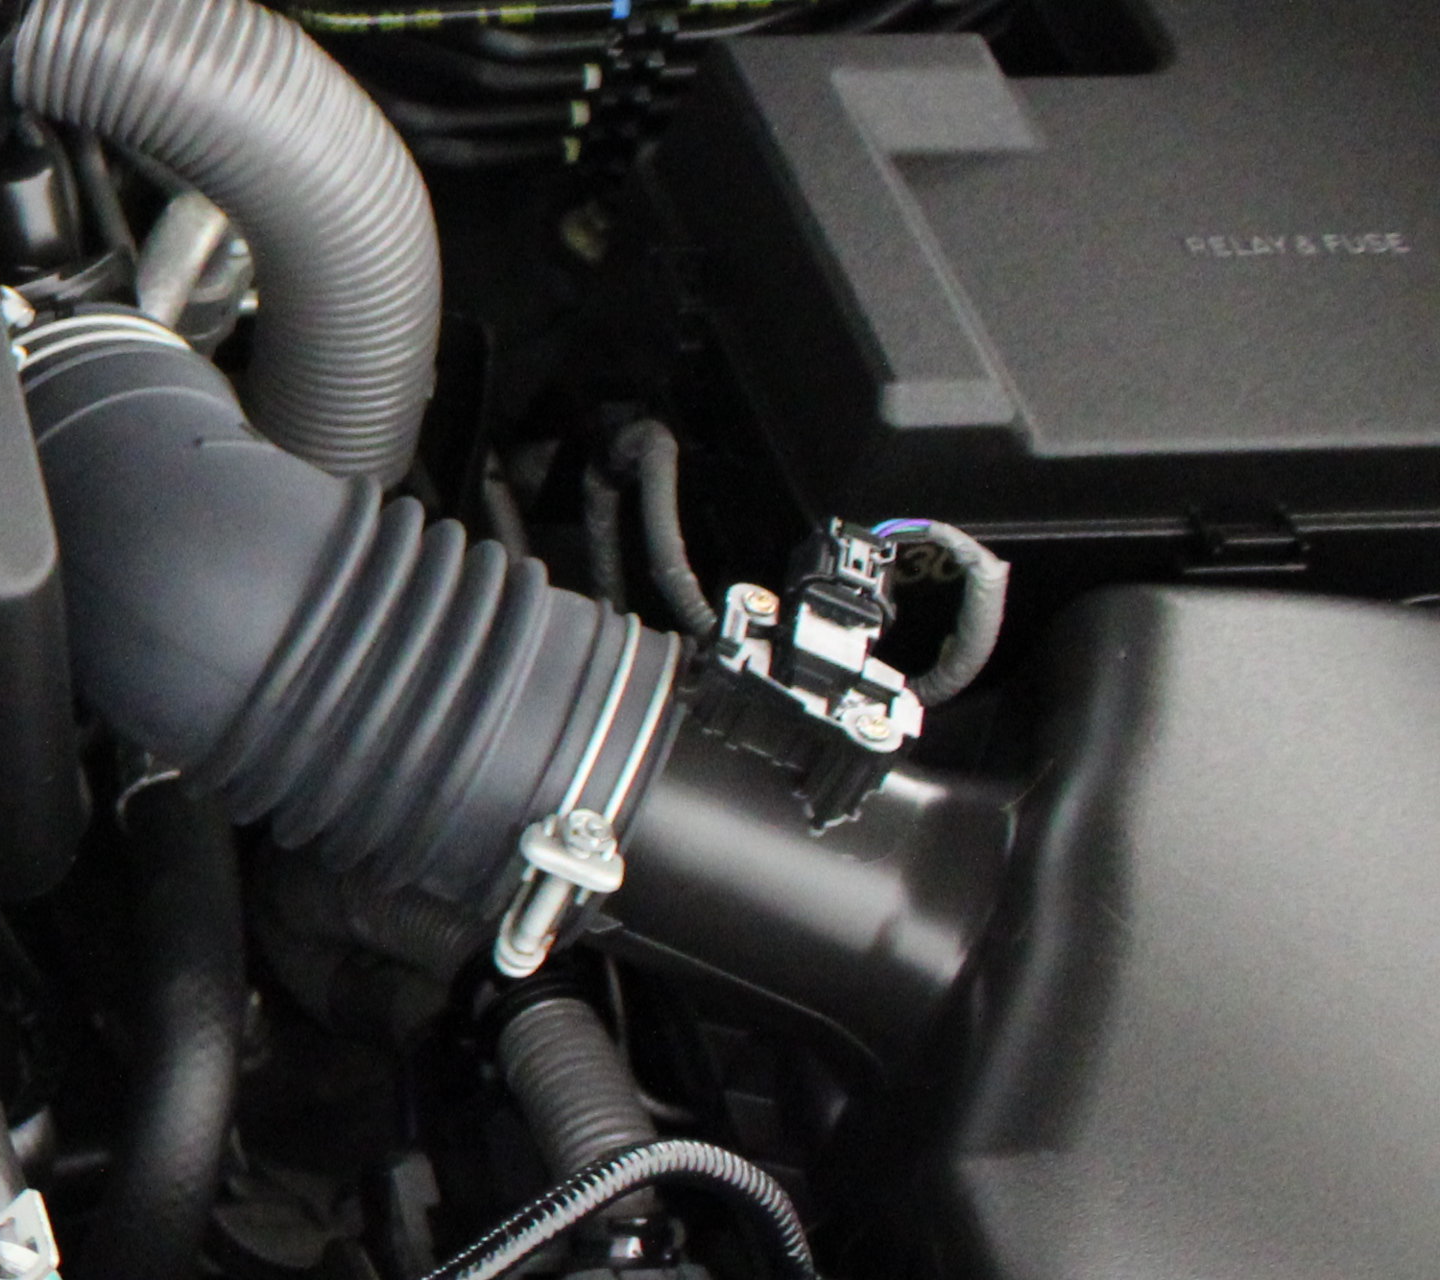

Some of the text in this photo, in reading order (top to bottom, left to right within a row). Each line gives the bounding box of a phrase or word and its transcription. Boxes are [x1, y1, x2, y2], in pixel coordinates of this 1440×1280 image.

[1184, 232, 1411, 257] RELAY & FUSE
